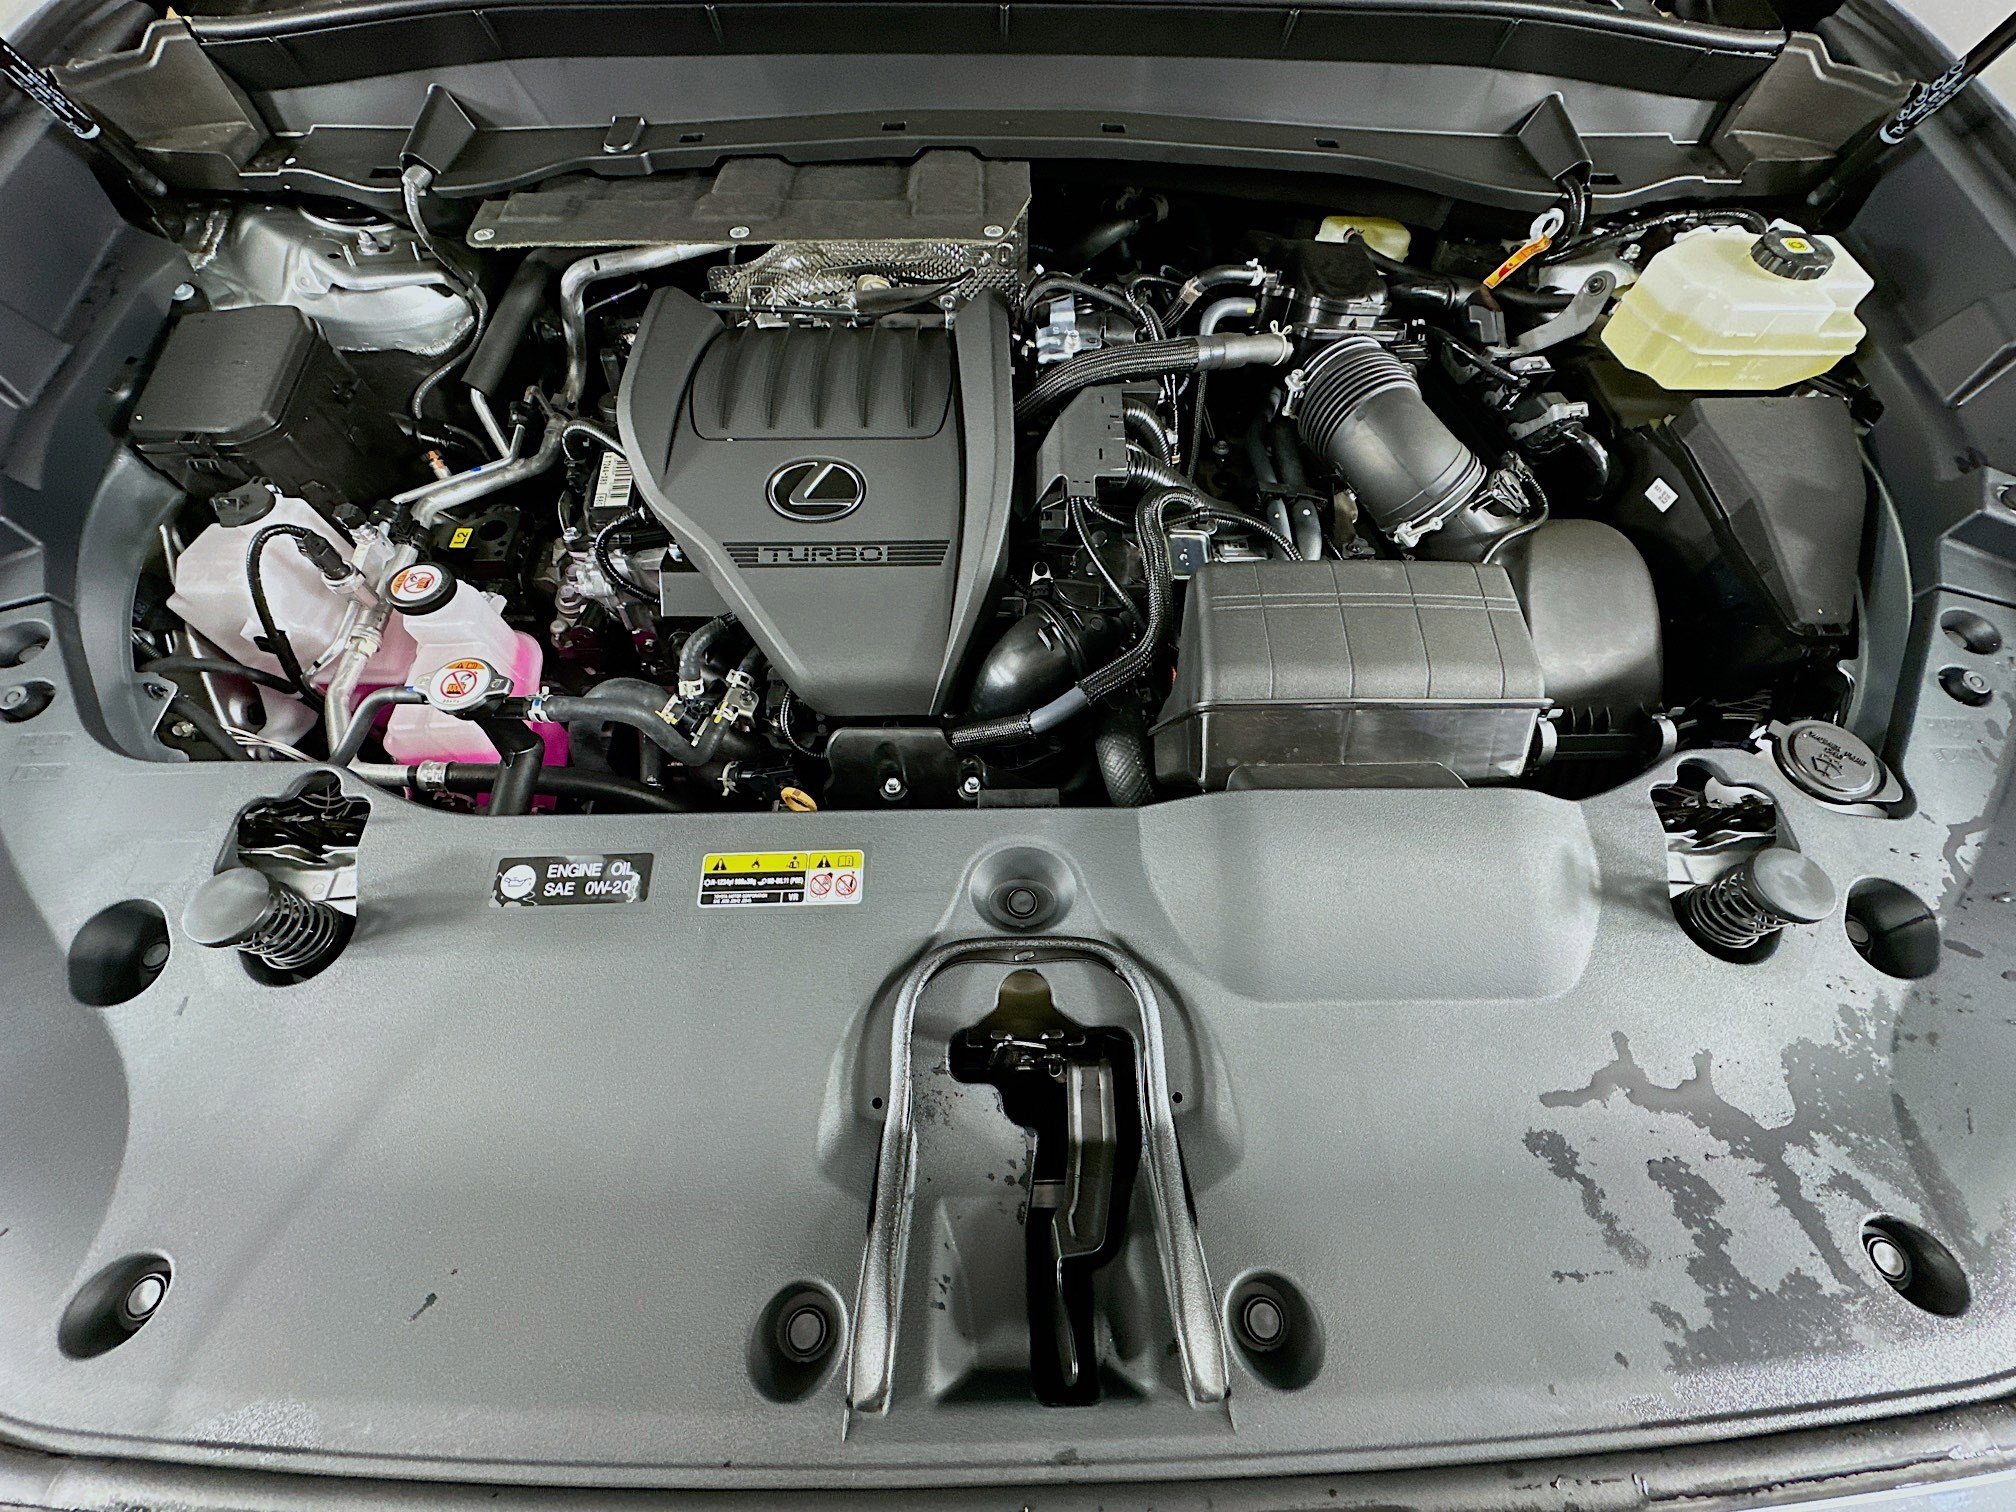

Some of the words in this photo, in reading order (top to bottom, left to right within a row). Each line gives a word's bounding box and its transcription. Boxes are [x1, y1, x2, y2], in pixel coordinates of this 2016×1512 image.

[453, 531, 469, 545] L2
[762, 545, 884, 563] TURBO
[547, 863, 602, 878] ENGINE
[610, 861, 636, 876] OIL
[543, 882, 575, 897] SAE
[584, 880, 631, 896] 0W-20
[788, 893, 799, 901] VR
